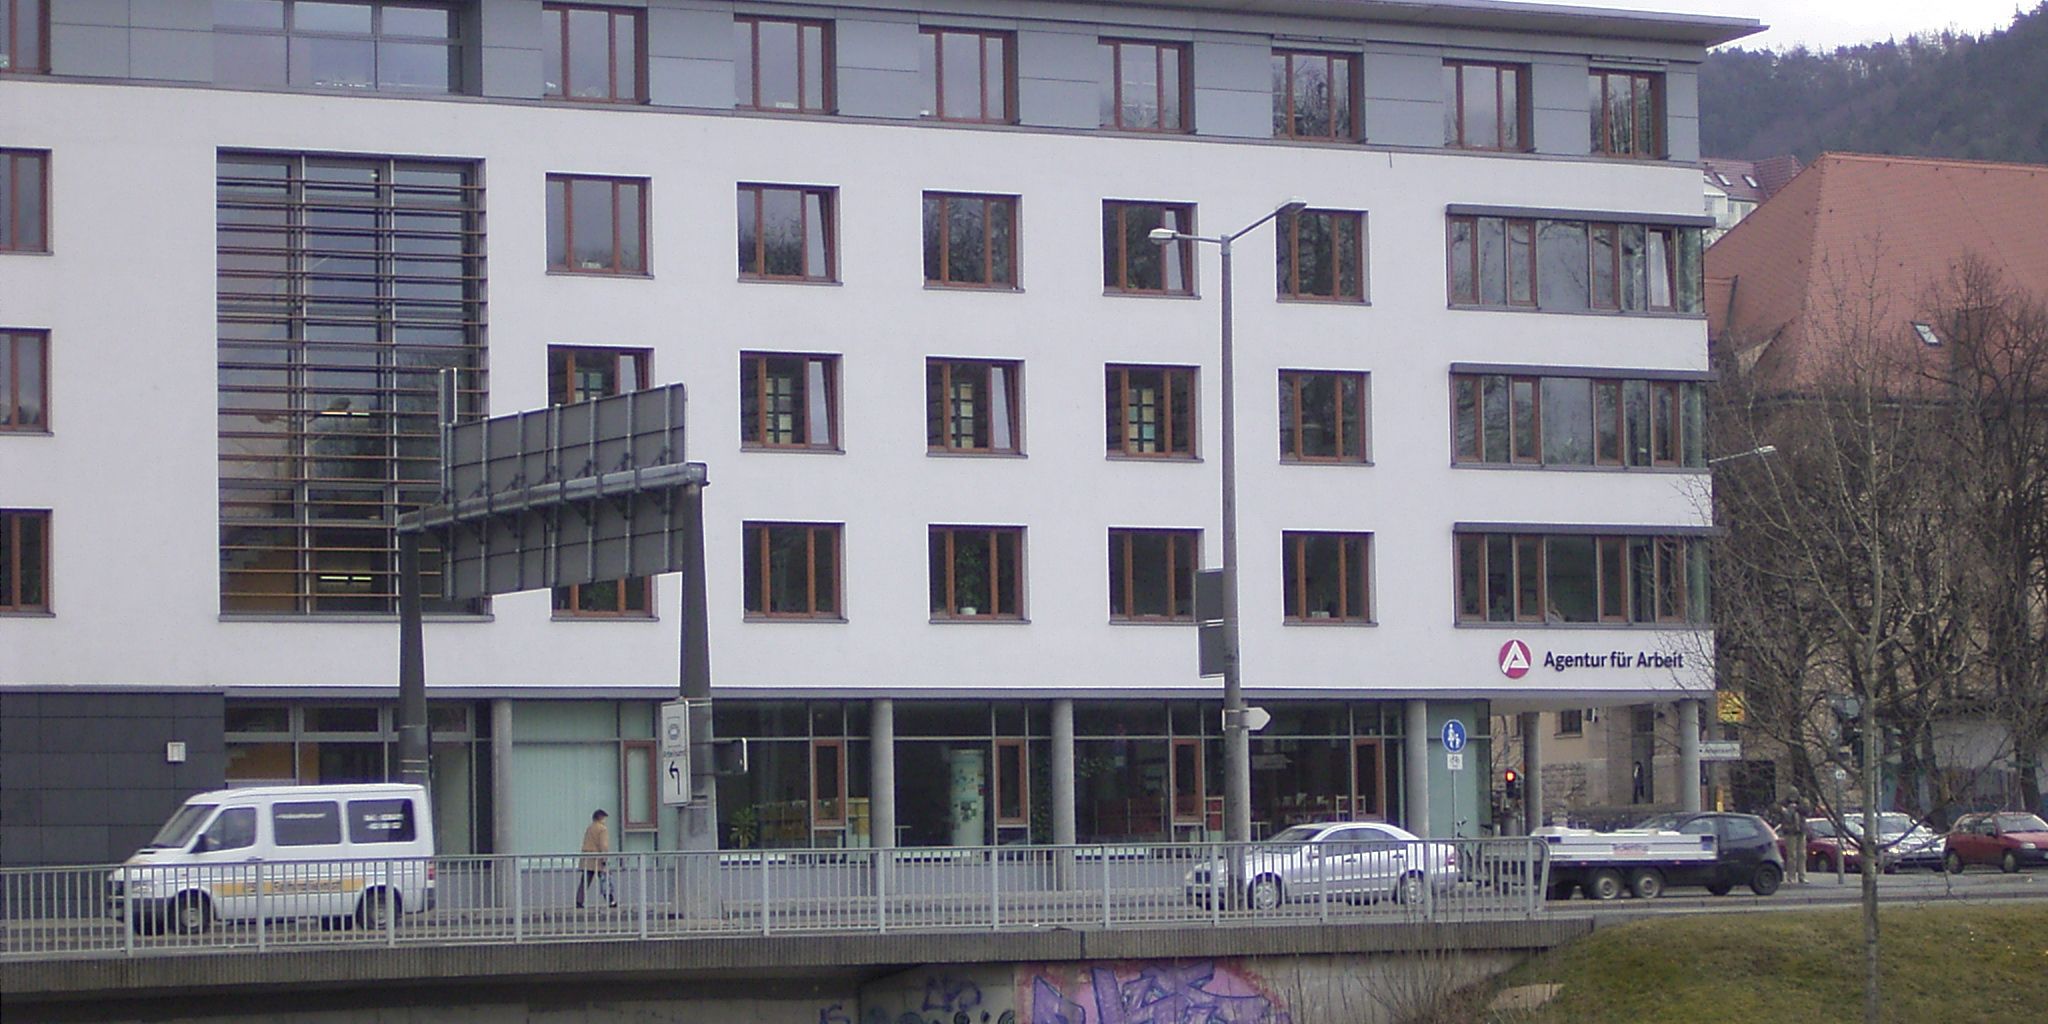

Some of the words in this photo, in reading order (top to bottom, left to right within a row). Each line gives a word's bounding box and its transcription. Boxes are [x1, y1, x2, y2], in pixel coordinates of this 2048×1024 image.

[1544, 651, 1608, 671] Agentur
[1610, 651, 1634, 668] für
[1636, 651, 1684, 668] Arbeit
